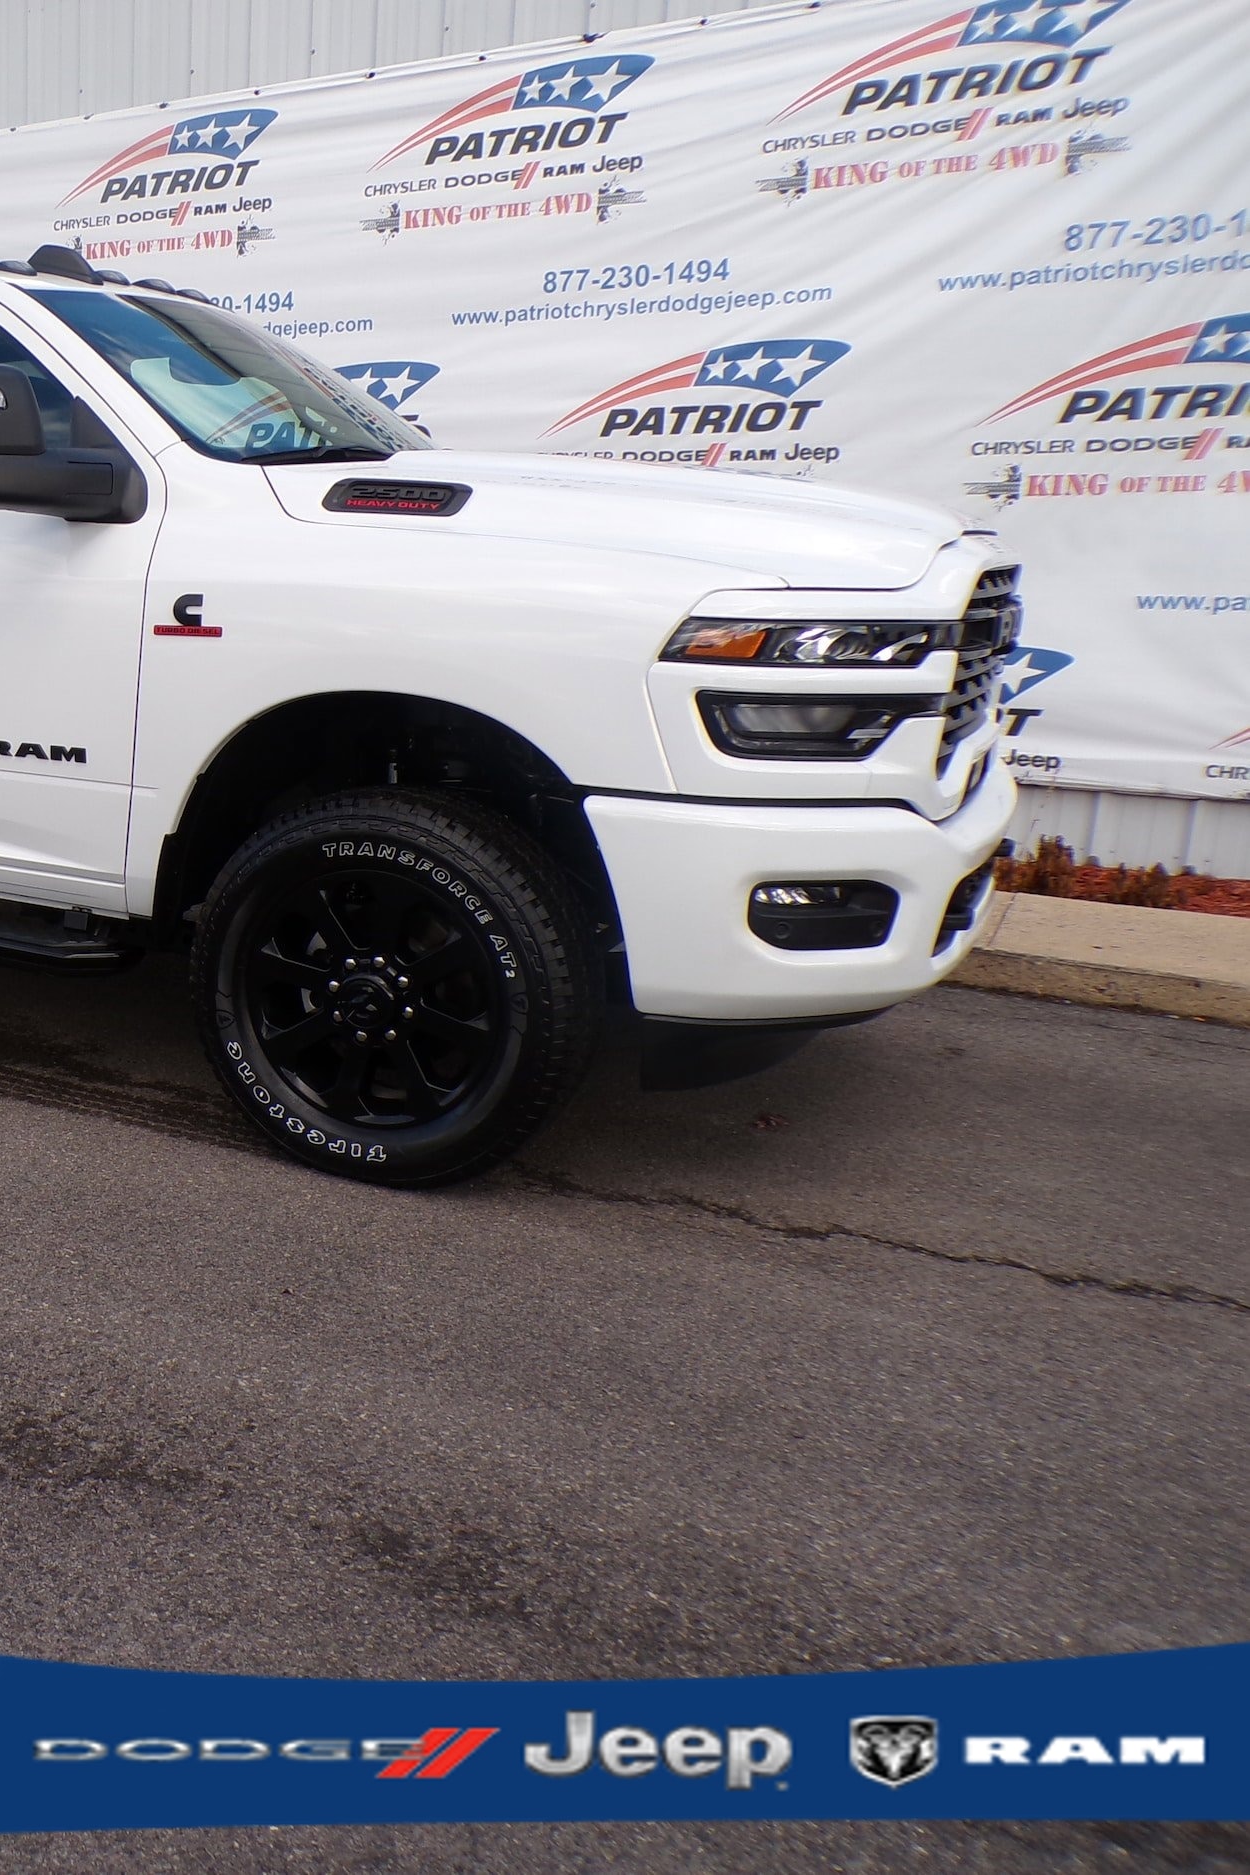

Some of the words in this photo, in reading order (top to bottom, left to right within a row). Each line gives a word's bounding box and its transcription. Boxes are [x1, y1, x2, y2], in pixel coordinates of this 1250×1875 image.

[841, 46, 1115, 115] PATRIOT
[424, 112, 630, 166] PATRIOT
[762, 131, 856, 153] CHRYSLER
[866, 117, 968, 142] DODGE
[995, 107, 1053, 127] RAM
[1063, 97, 1130, 120] Jeep
[100, 160, 260, 203] PATRIOT
[364, 178, 437, 197] CHRYSLER
[444, 169, 524, 188] DODGE
[543, 163, 585, 178] RAM
[592, 155, 643, 174] Jeep
[813, 161, 890, 190] KING
[899, 158, 925, 178] OF
[933, 154, 978, 174] THE
[990, 142, 1061, 171] 4WD
[53, 215, 111, 231] CHRYSLER
[116, 208, 178, 224] DODGE
[193, 203, 226, 217] RAM
[232, 196, 272, 213] Jeep
[404, 205, 462, 230] KING
[469, 205, 491, 222] OF
[495, 201, 531, 218] THE
[539, 192, 593, 216] 4WD
[1064, 208, 1248, 251] 877-230-1
[86, 239, 131, 260] KING
[137, 240, 153, 254] OF
[156, 237, 185, 250] THE
[190, 230, 233, 250] 4WD
[542, 258, 731, 293] 877-230-1494
[451, 285, 833, 327] www.patriotchryslerdodgejeep.com
[600, 400, 824, 437] PATRIOT
[622, 450, 709, 463] DODGE
[729, 449, 777, 462] RAM
[785, 443, 840, 463] Jeep
[971, 439, 1075, 456] CHRYSLER
[1085, 435, 1200, 453] DODGE
[352, 487, 447, 501] 2500
[1026, 473, 1109, 497] KING
[1119, 476, 1151, 493] OF
[1157, 475, 1207, 492] THE
[346, 499, 395, 508] HEAVY
[398, 501, 440, 510] DUTY
[1004, 749, 1060, 771] Jeep
[322, 841, 494, 925] TRANSFORCE
